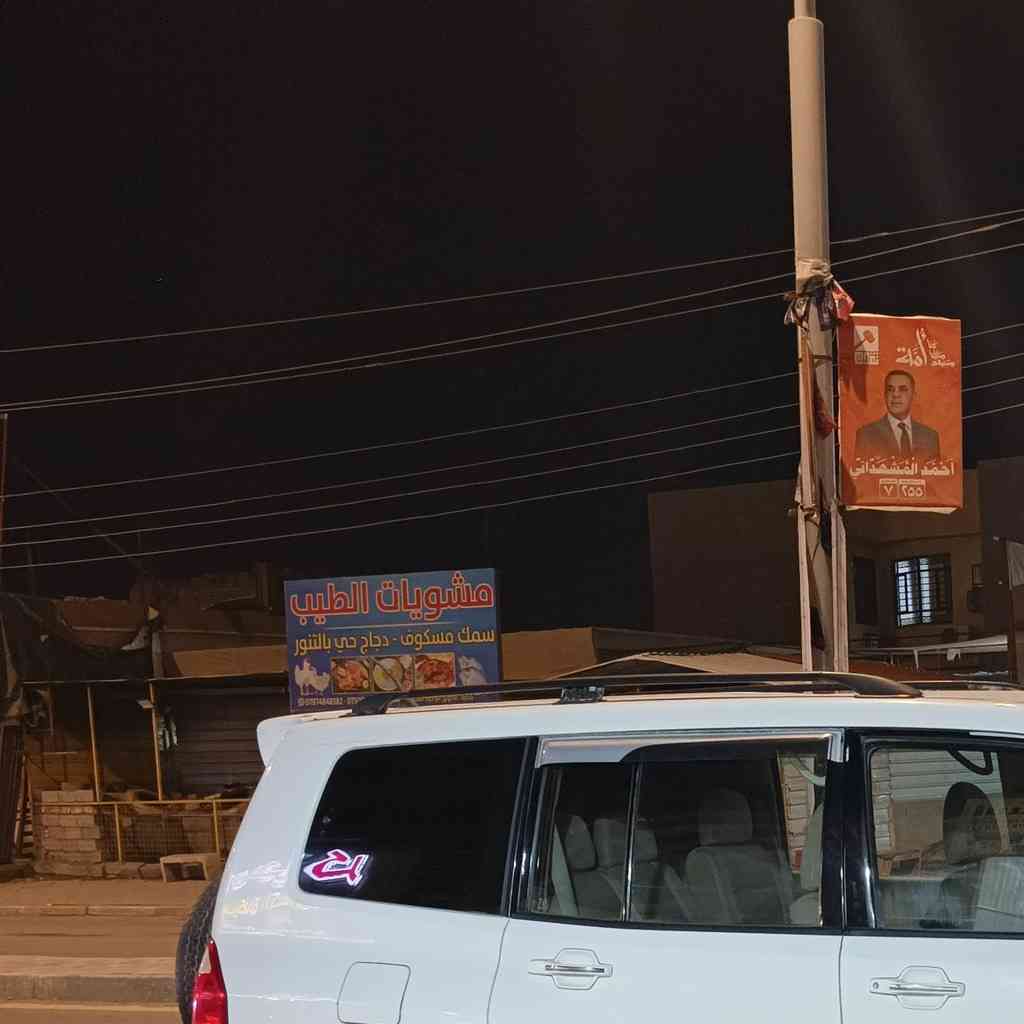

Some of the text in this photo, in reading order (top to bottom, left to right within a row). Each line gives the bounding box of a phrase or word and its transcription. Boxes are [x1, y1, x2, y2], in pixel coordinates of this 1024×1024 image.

[290, 570, 494, 625] مشويات الطيب
[294, 624, 496, 656] سمك مسكوف دجاج حي بالتنور
